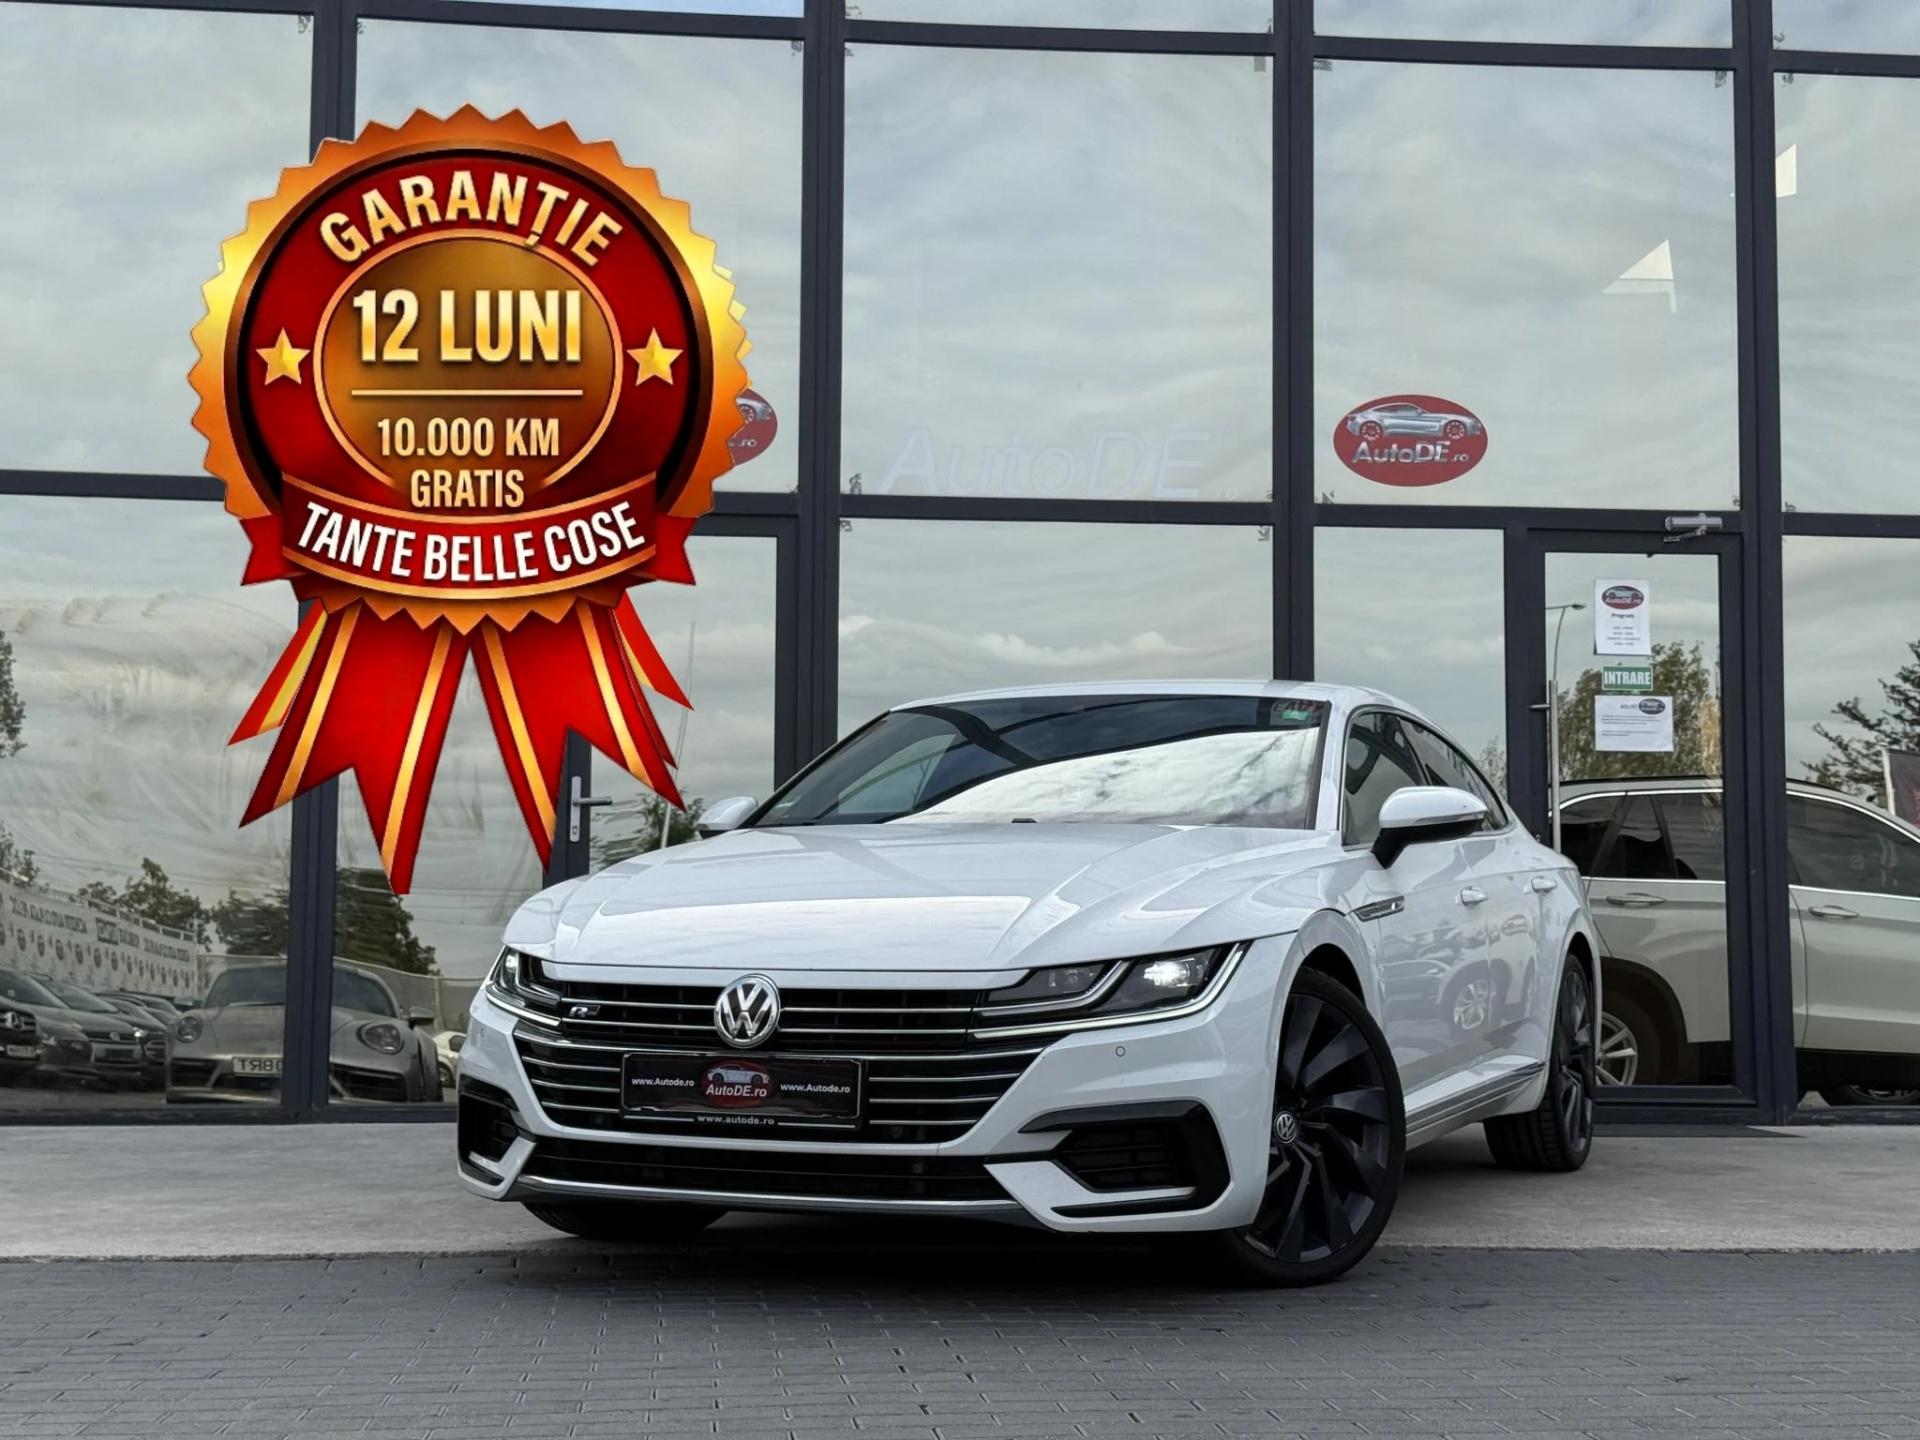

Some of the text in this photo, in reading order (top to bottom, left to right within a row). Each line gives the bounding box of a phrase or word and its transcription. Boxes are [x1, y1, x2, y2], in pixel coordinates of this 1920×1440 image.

[1603, 671, 1651, 685] INTRARE
[631, 1077, 695, 1088] www.Autode.ro
[780, 1082, 851, 1094] www.Autode.ro
[705, 1083, 768, 1098] AutoDE.ro
[696, 1115, 775, 1126] www.autode.ro
